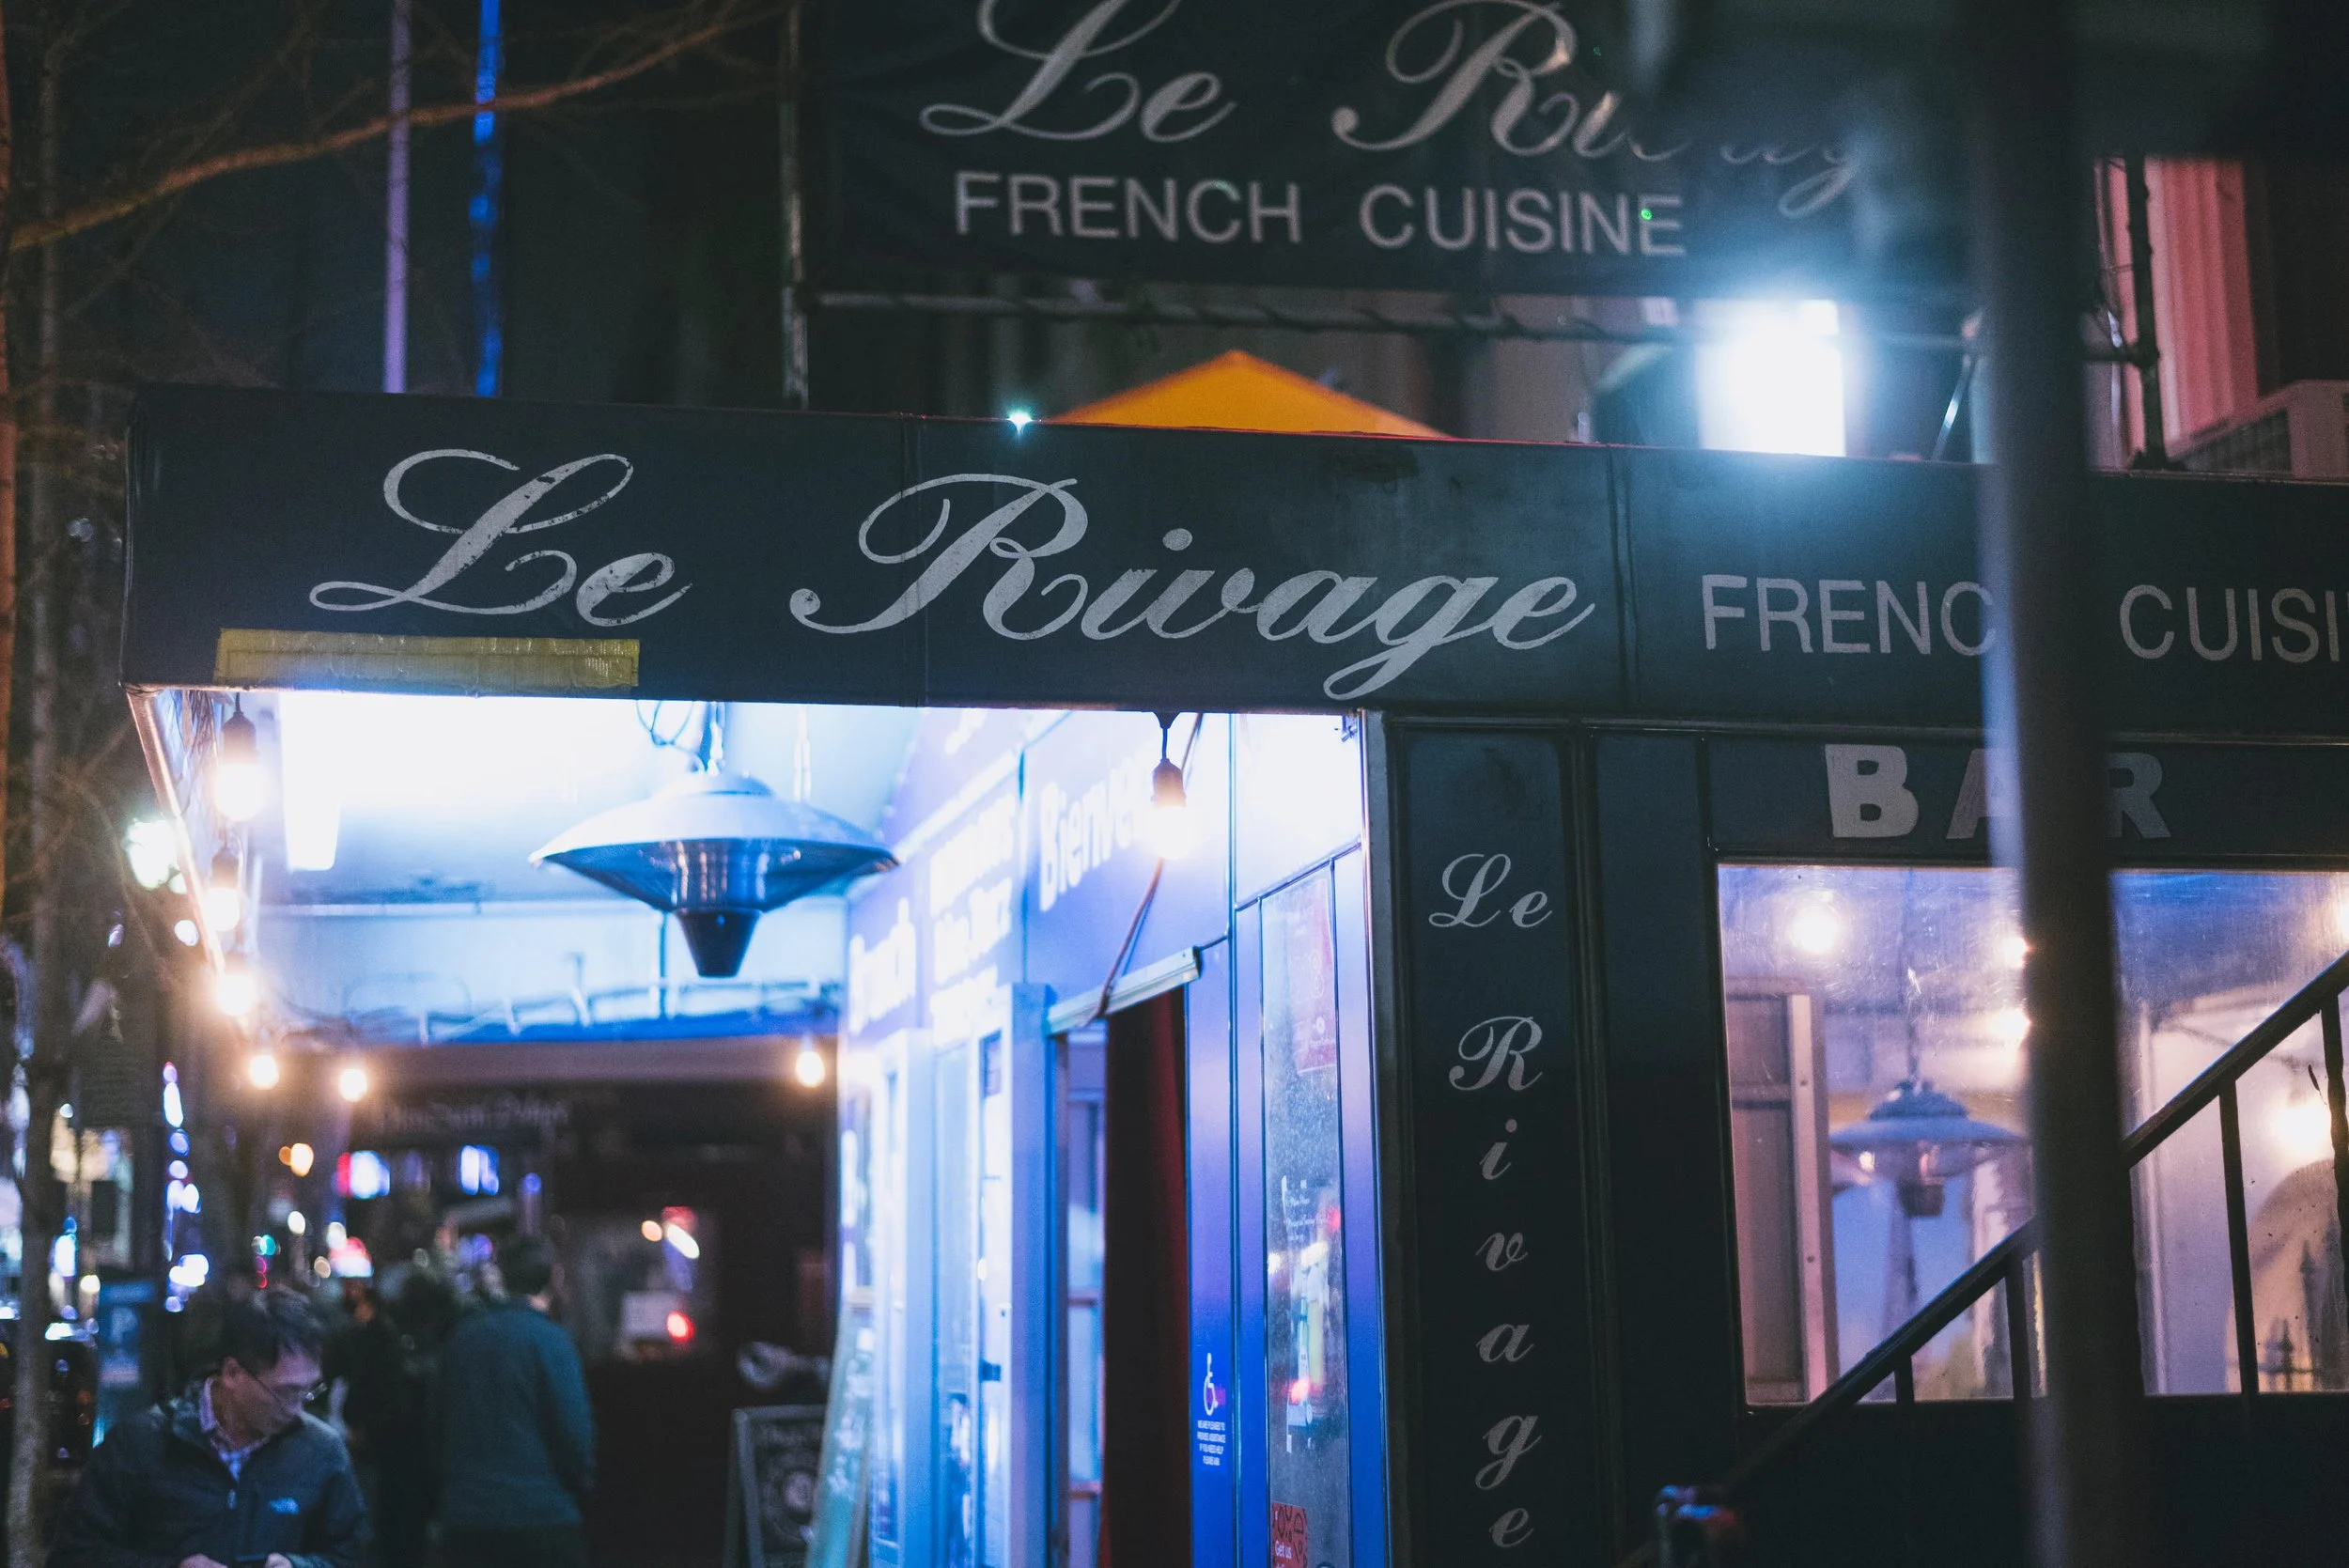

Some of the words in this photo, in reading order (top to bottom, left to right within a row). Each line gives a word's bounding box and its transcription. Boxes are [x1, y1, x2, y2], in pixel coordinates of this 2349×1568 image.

[918, 0, 1237, 142] Le
[955, 171, 1302, 245] FRENCH
[1359, 184, 1686, 257] CUISINE
[307, 447, 693, 628] Le
[788, 473, 1596, 703] Rivage
[1701, 573, 1999, 657] FRENC
[2119, 583, 2349, 664] CUISI
[1428, 853, 1553, 928] Le
